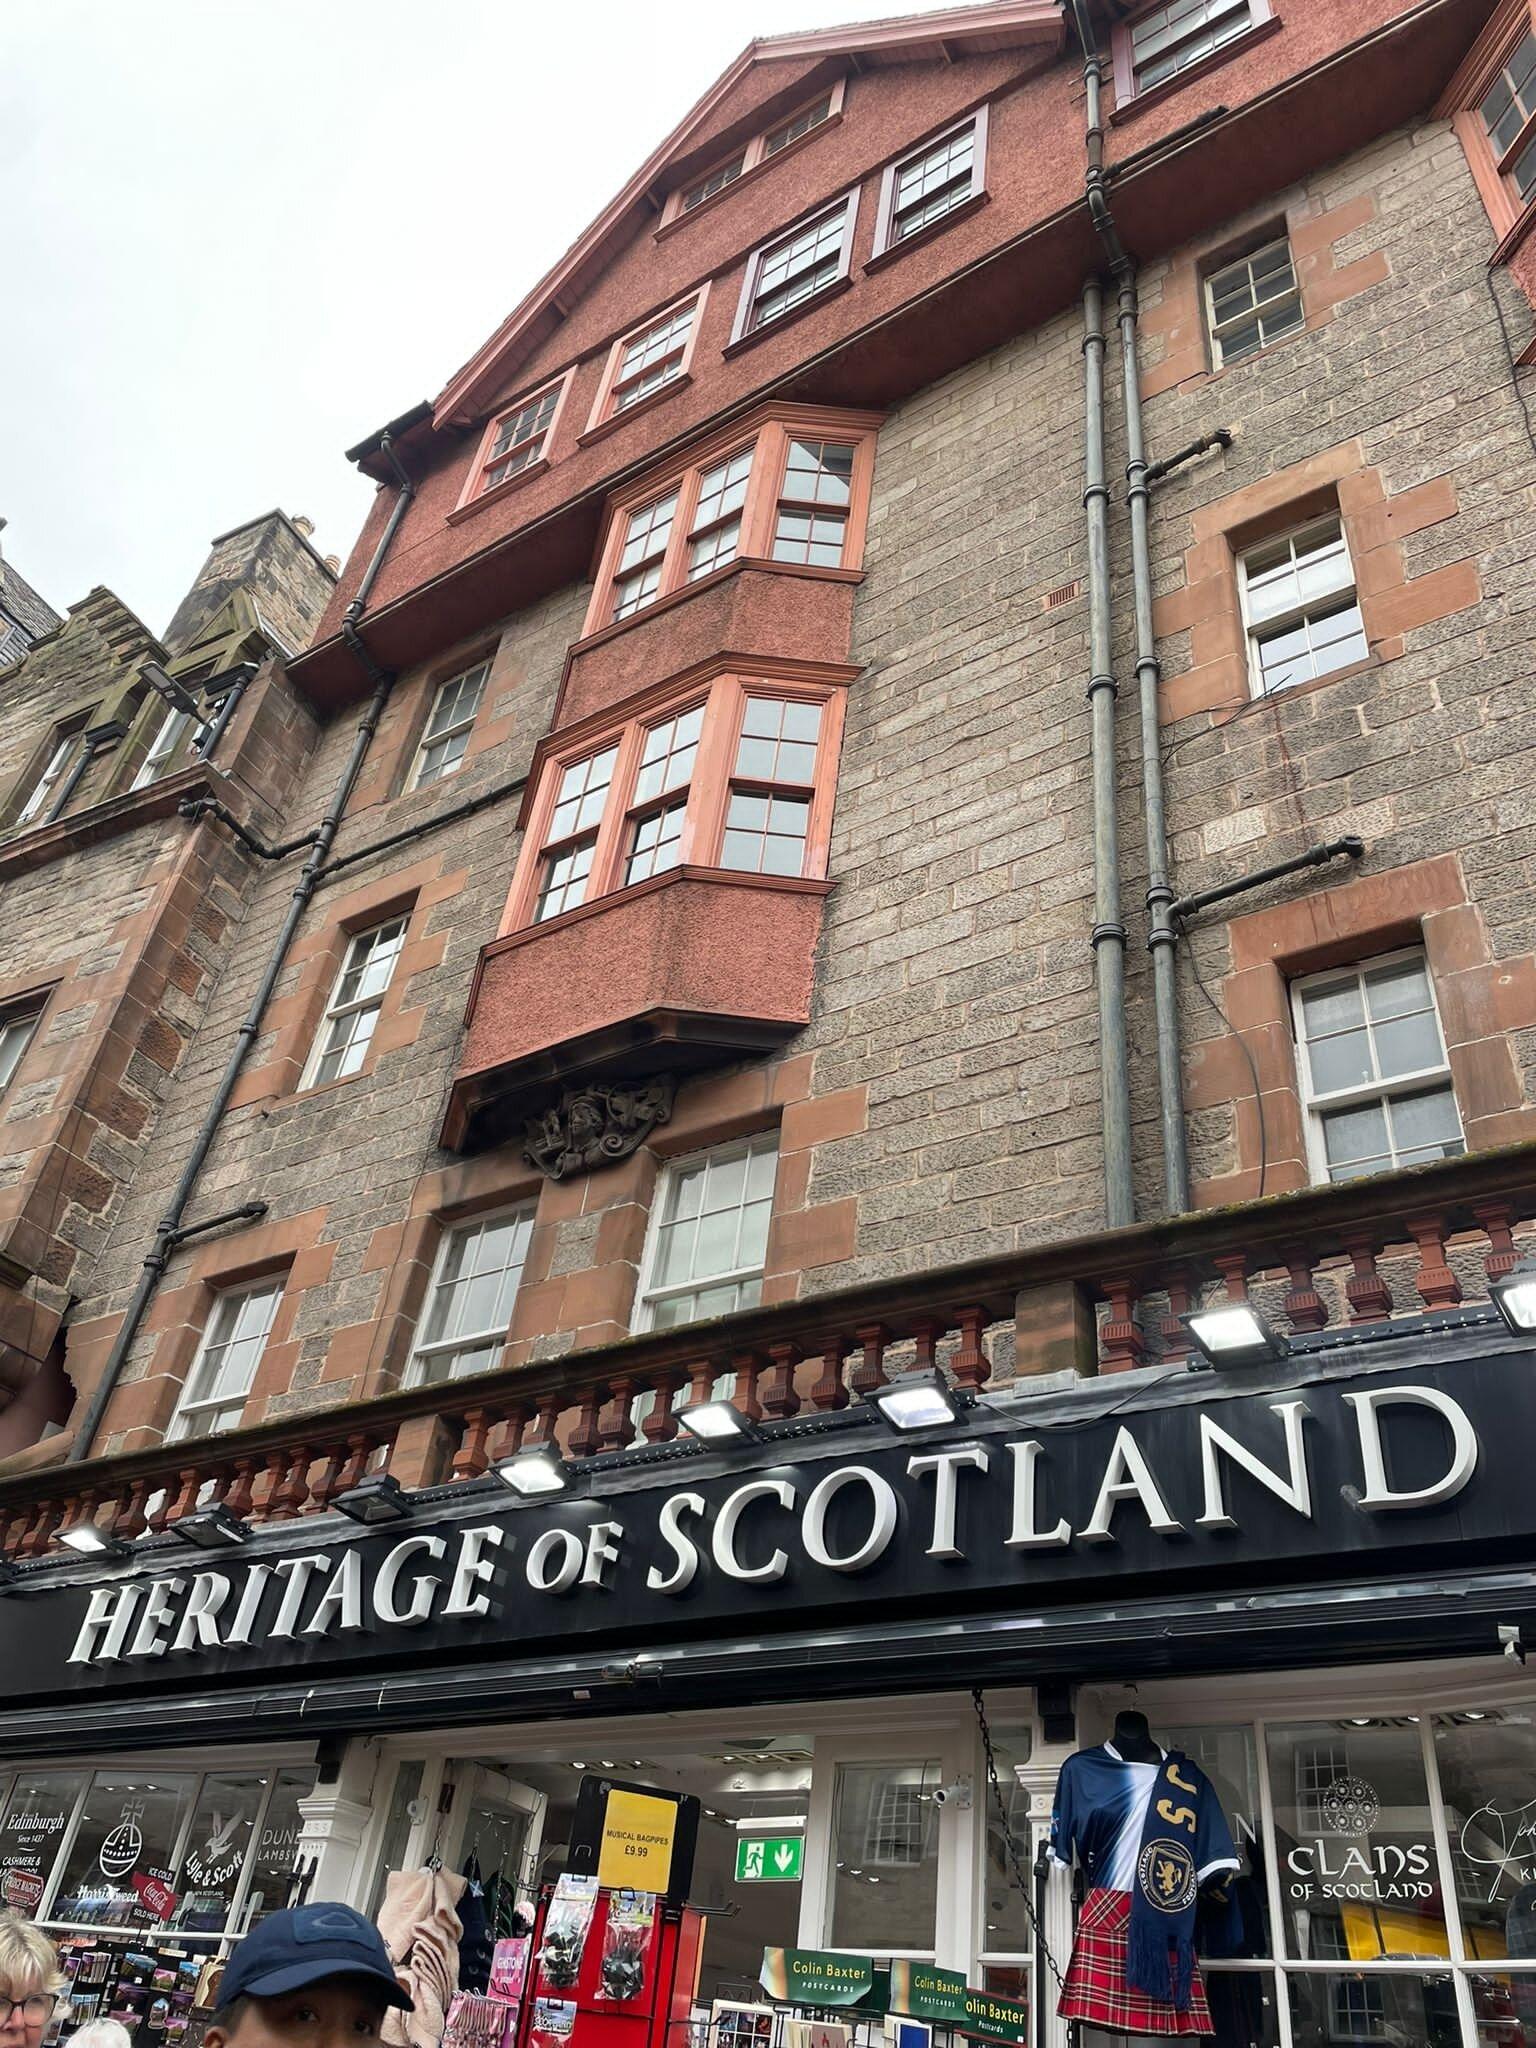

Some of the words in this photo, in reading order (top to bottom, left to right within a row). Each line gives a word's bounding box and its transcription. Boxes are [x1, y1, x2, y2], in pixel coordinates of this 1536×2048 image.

[65, 1524, 504, 1665] HERITAGE
[525, 1520, 623, 1594] OF
[646, 1385, 1479, 1595] SCOTLAND
[7, 1811, 65, 1834] Edinburgh
[17, 1834, 30, 1844] Since
[606, 1829, 636, 1841] MUSICAL
[636, 1833, 669, 1846] BAGPIPES
[625, 1844, 648, 1857] £9.99
[2, 1856, 36, 1866] CASHMERE
[185, 1849, 203, 1884] Lyle
[202, 1866, 212, 1887] &
[211, 1849, 244, 1886] Scott
[1287, 1839, 1430, 1880] CLANS
[148, 1867, 159, 1877] ICE
[159, 1870, 173, 1881] COLD
[1290, 1883, 1314, 1902] OF
[1321, 1880, 1433, 1899] SCOTLAND
[133, 1907, 146, 1917] SOLD
[145, 1911, 160, 1922] HERE
[793, 1960, 822, 1975] Colin
[826, 1963, 866, 1980] Baxter
[802, 1981, 855, 1993] POSTCARDS
[914, 1975, 935, 1990] Colin
[936, 1979, 963, 1995] Baxter
[920, 1996, 955, 2008] POSTCARDS
[965, 1997, 987, 2016] olin
[989, 2004, 1025, 2025] Baxter
[978, 2020, 1004, 2034] Postcards
